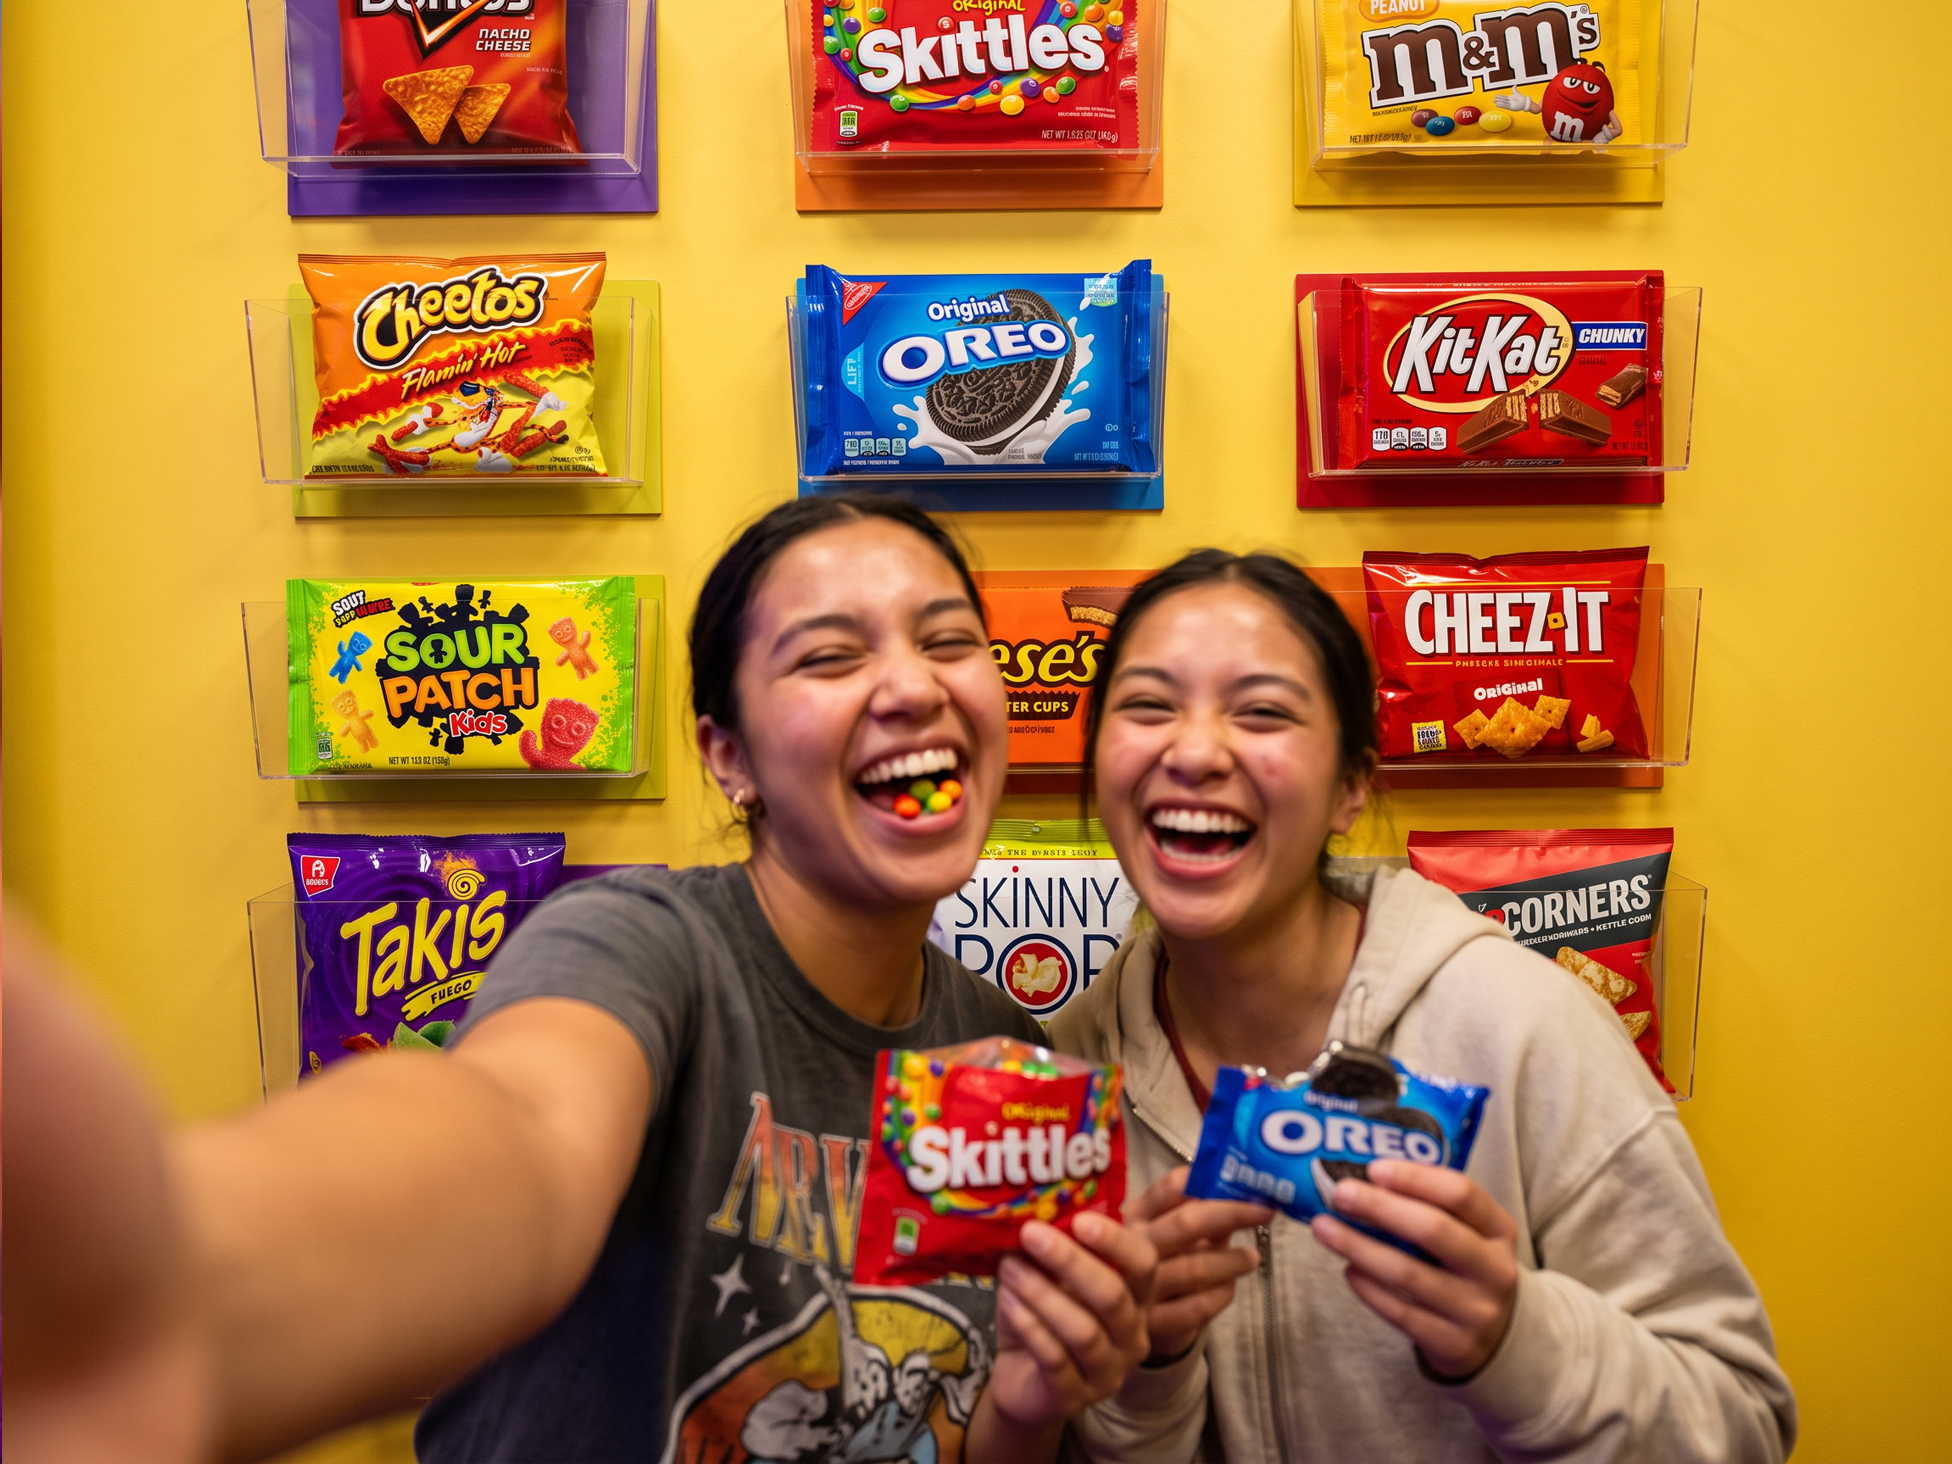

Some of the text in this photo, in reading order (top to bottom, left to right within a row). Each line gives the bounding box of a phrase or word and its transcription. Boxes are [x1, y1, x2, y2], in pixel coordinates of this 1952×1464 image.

[1371, 0, 1425, 15] PEANUT
[476, 40, 531, 51] CHEESE
[479, 28, 530, 39] NACHO
[857, 14, 1106, 94] Skittles
[359, 268, 545, 364] Cheetos
[928, 294, 1011, 323] Original
[1578, 328, 1645, 344] CHUNKY
[480, 341, 526, 369] Hot
[882, 323, 1066, 382] OREO
[1392, 316, 1562, 393] KitKat
[386, 623, 526, 672] SOUR
[383, 667, 539, 719] PATCH
[1033, 701, 1069, 713] CUPS
[451, 709, 508, 737] Kids
[388, 756, 399, 765] NET
[400, 756, 409, 765] WT
[1488, 874, 1652, 936] CORNERS
[1596, 918, 1627, 932] KETTLE
[430, 979, 472, 1005] FUEGO
[1261, 1109, 1441, 1165] OREO
[906, 1124, 1112, 1193] Skittles
